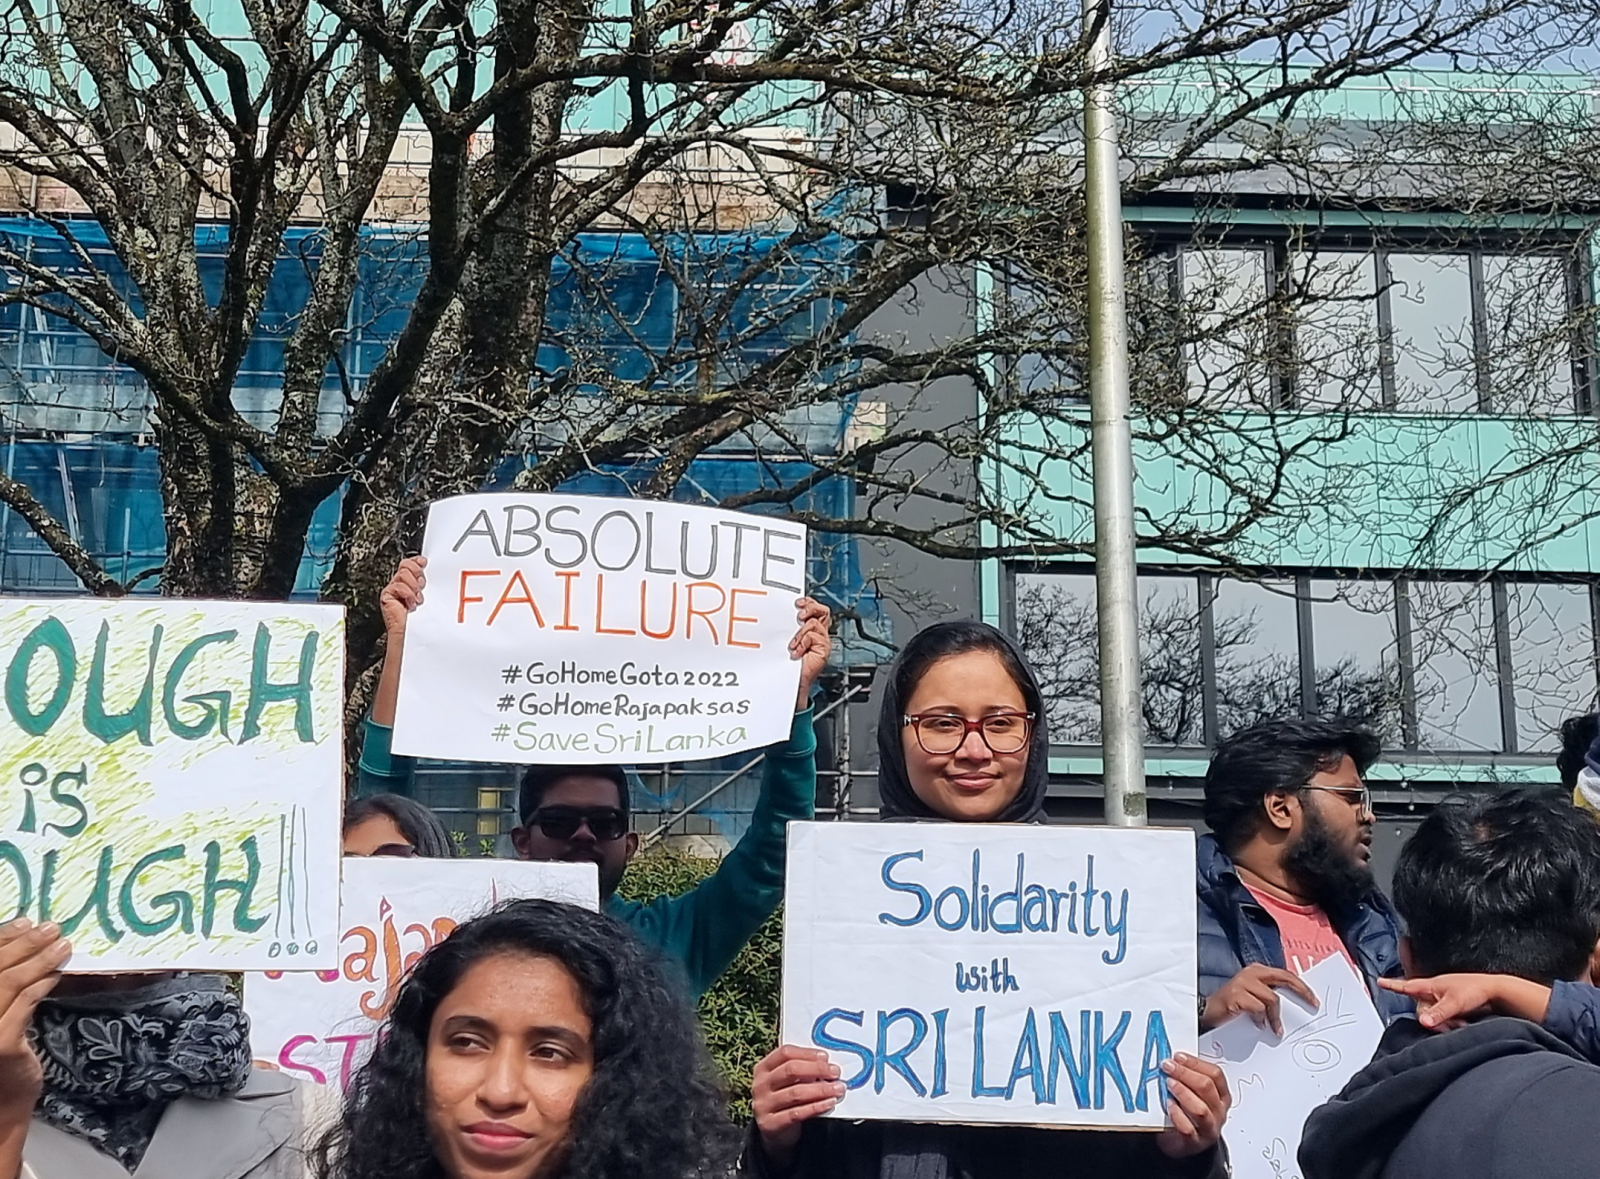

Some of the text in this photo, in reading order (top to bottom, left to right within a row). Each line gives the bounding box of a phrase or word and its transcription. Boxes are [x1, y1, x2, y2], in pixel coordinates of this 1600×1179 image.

[452, 505, 802, 594] ABSOLUTE
[457, 569, 768, 649] FAILURE
[501, 661, 740, 689] #GoHomeGota2022
[497, 693, 751, 720] #GoHomeRajapaksas
[491, 721, 748, 755] #SaveSriLanka
[878, 848, 1129, 964] Solidarity
[955, 957, 1020, 994] with
[811, 1006, 1173, 1116] SRI LANKA
